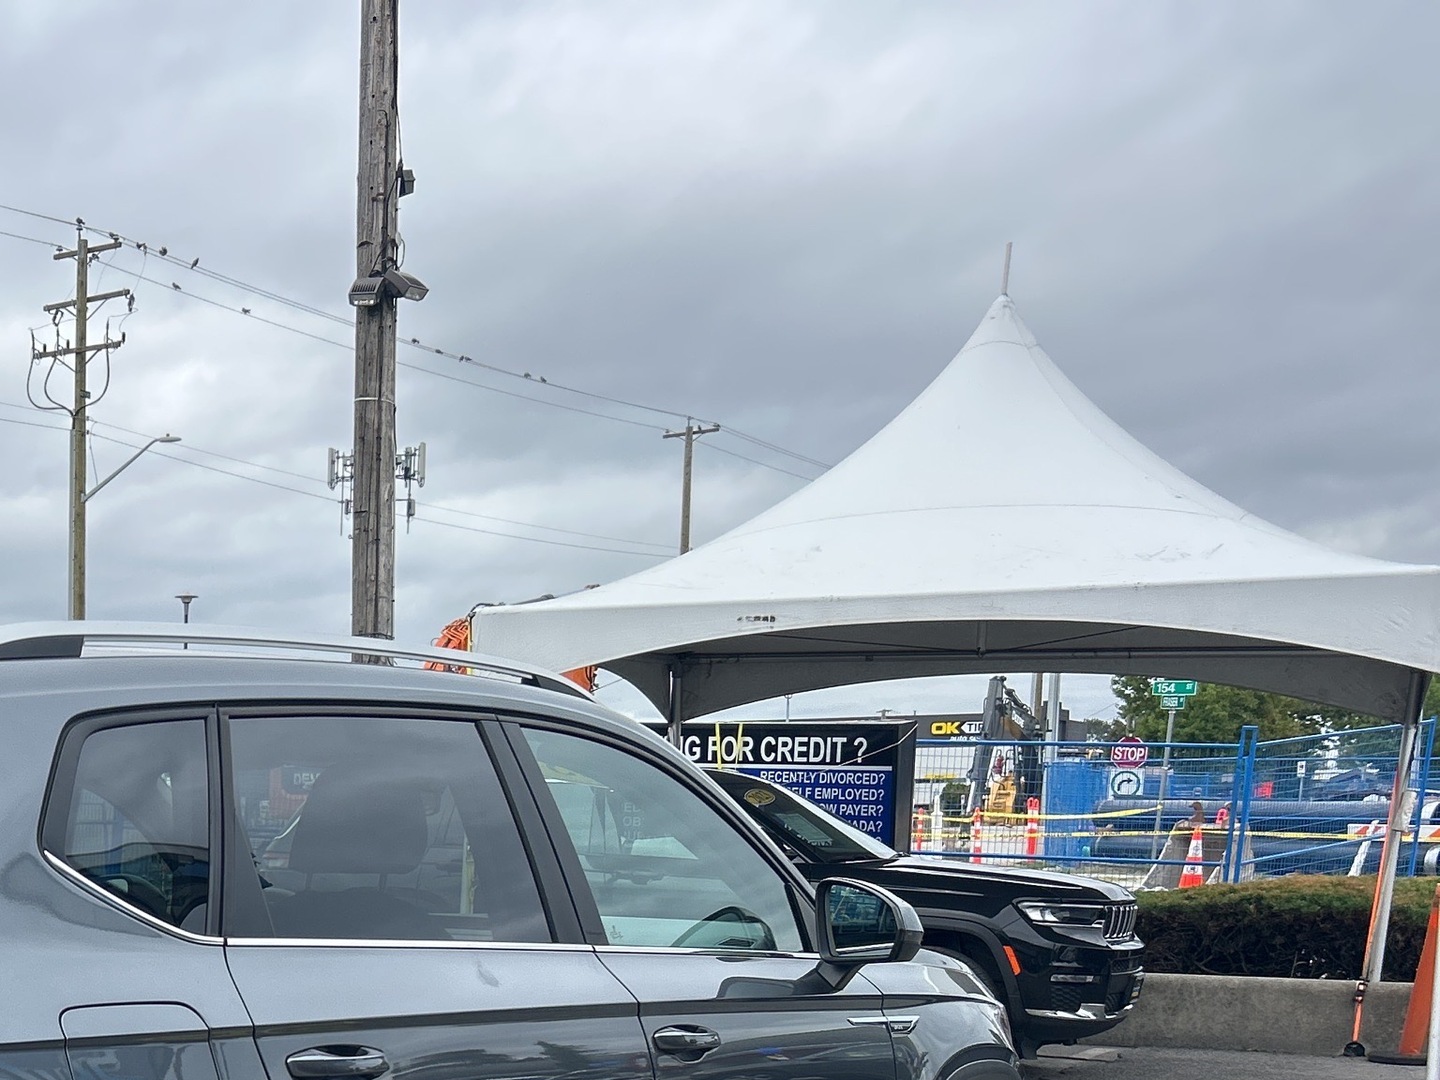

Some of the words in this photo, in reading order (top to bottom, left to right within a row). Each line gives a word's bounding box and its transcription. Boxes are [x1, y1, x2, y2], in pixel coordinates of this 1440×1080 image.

[1157, 683, 1176, 693] 154
[931, 721, 960, 735] OK
[707, 735, 754, 762] FOR
[760, 736, 847, 763] CREDIT
[854, 737, 868, 763] ?
[1113, 746, 1145, 760] STOP
[760, 771, 817, 784] RECENTLY
[819, 772, 885, 785] DIVORCED?
[814, 788, 885, 801] EMPLOYED?
[839, 804, 884, 817] PAYER?
